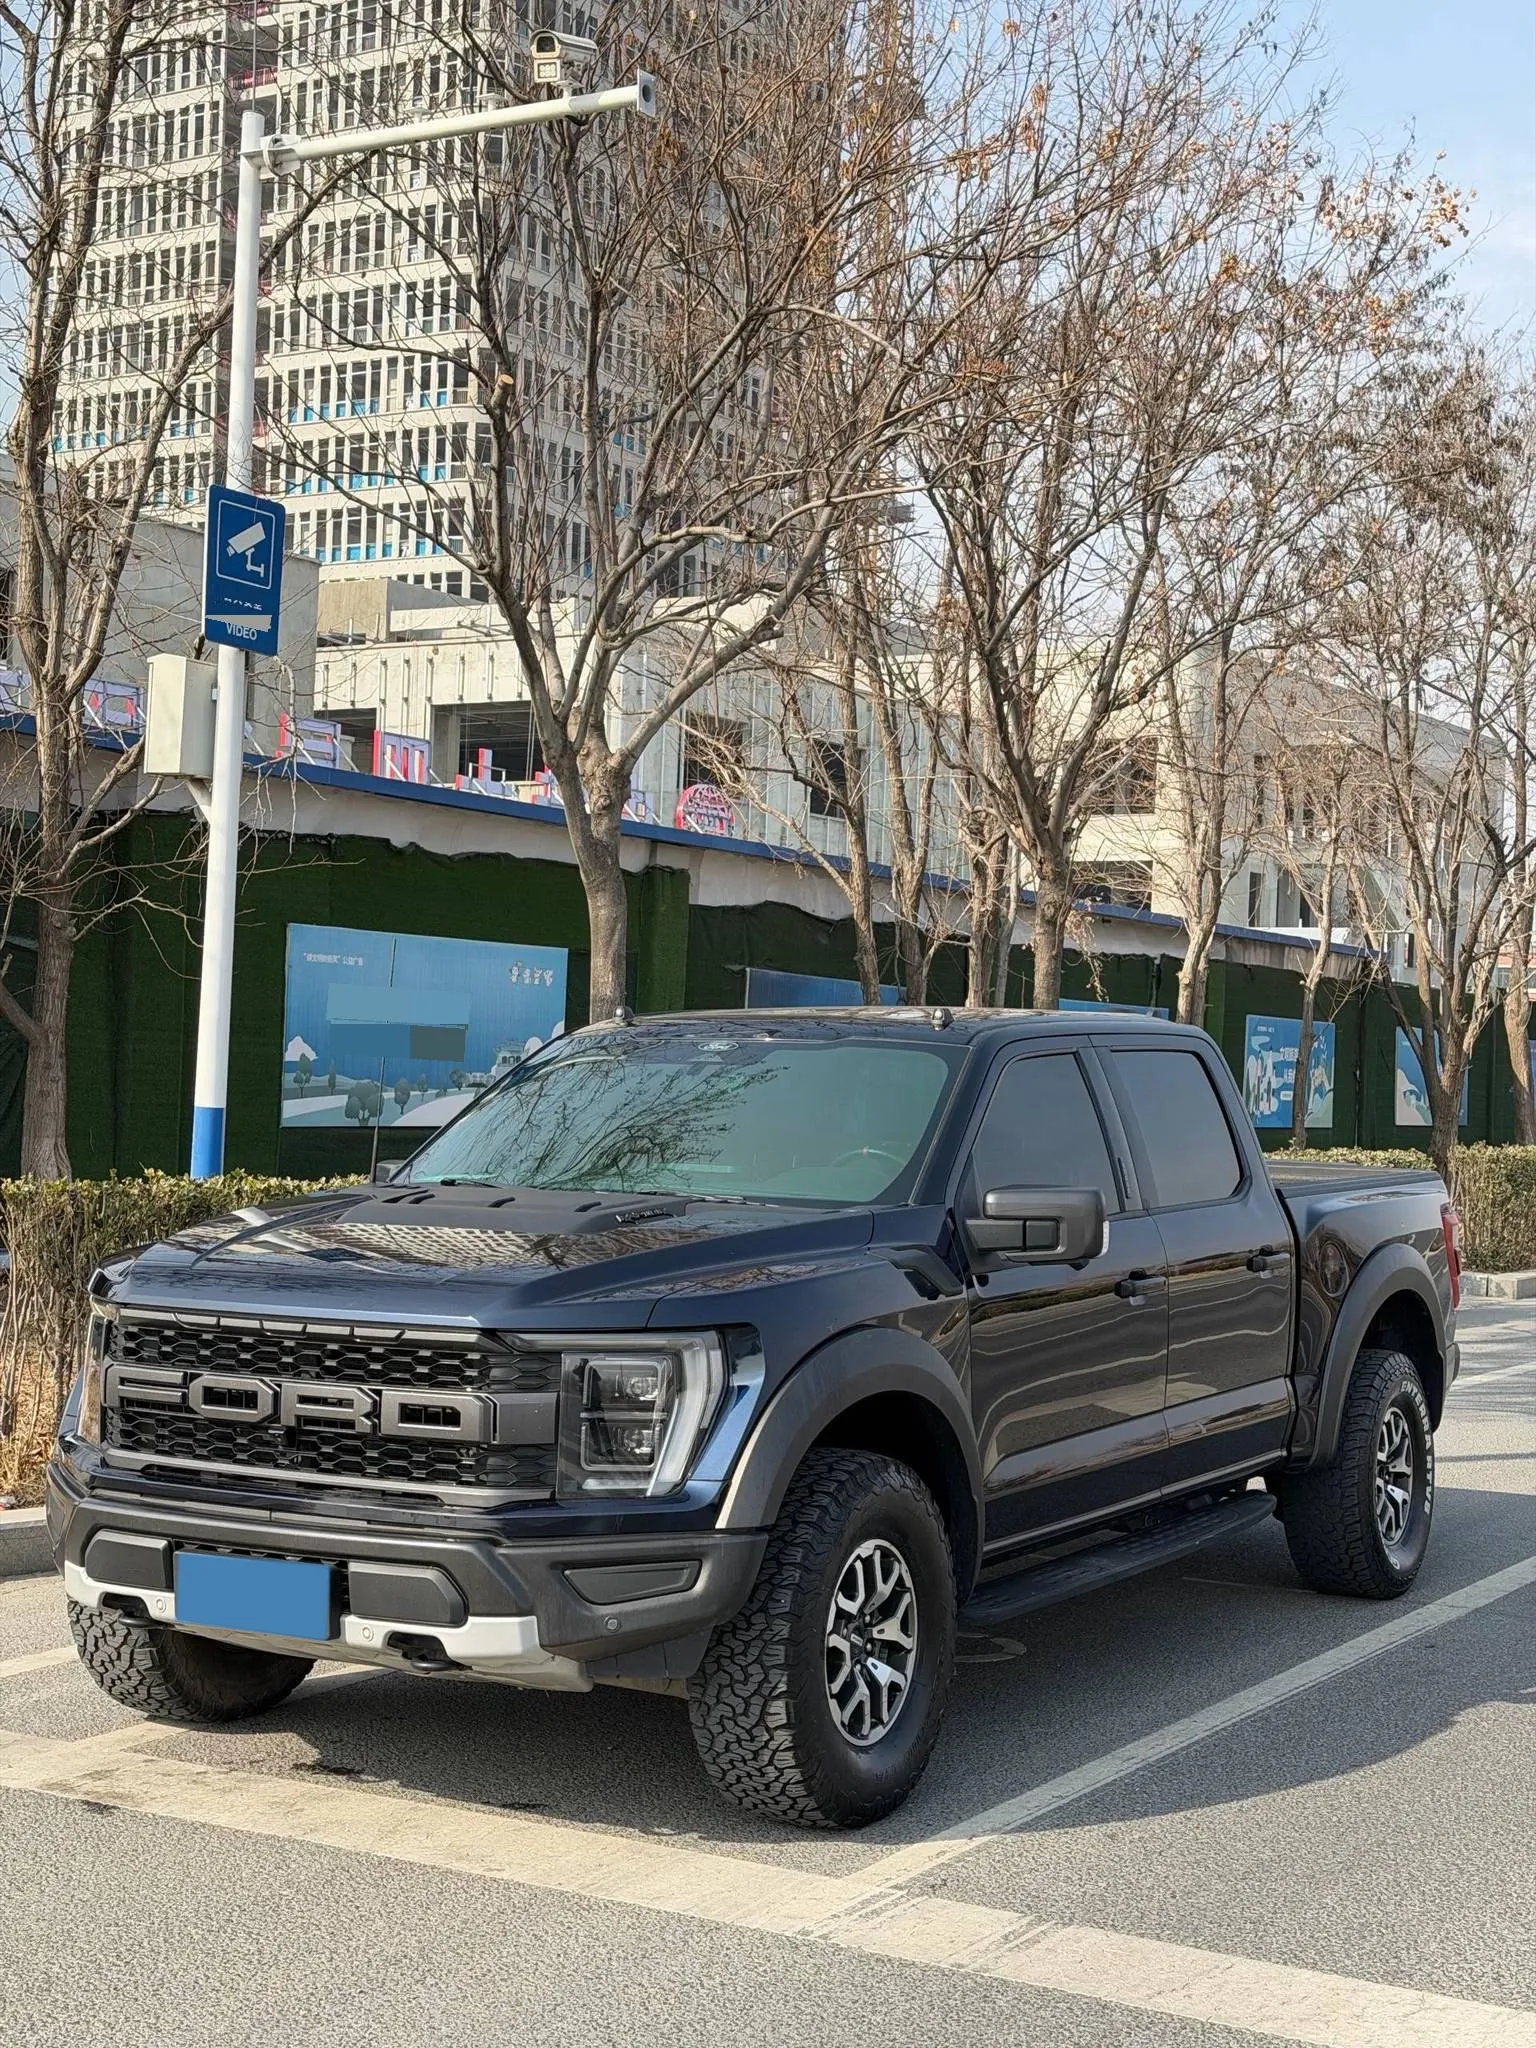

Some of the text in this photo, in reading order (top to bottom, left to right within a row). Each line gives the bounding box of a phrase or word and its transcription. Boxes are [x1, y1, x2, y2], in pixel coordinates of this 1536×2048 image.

[226, 622, 258, 641] VIDEO
[106, 1362, 490, 1443] FORD
[1401, 1380, 1432, 1450] ENTERRA
